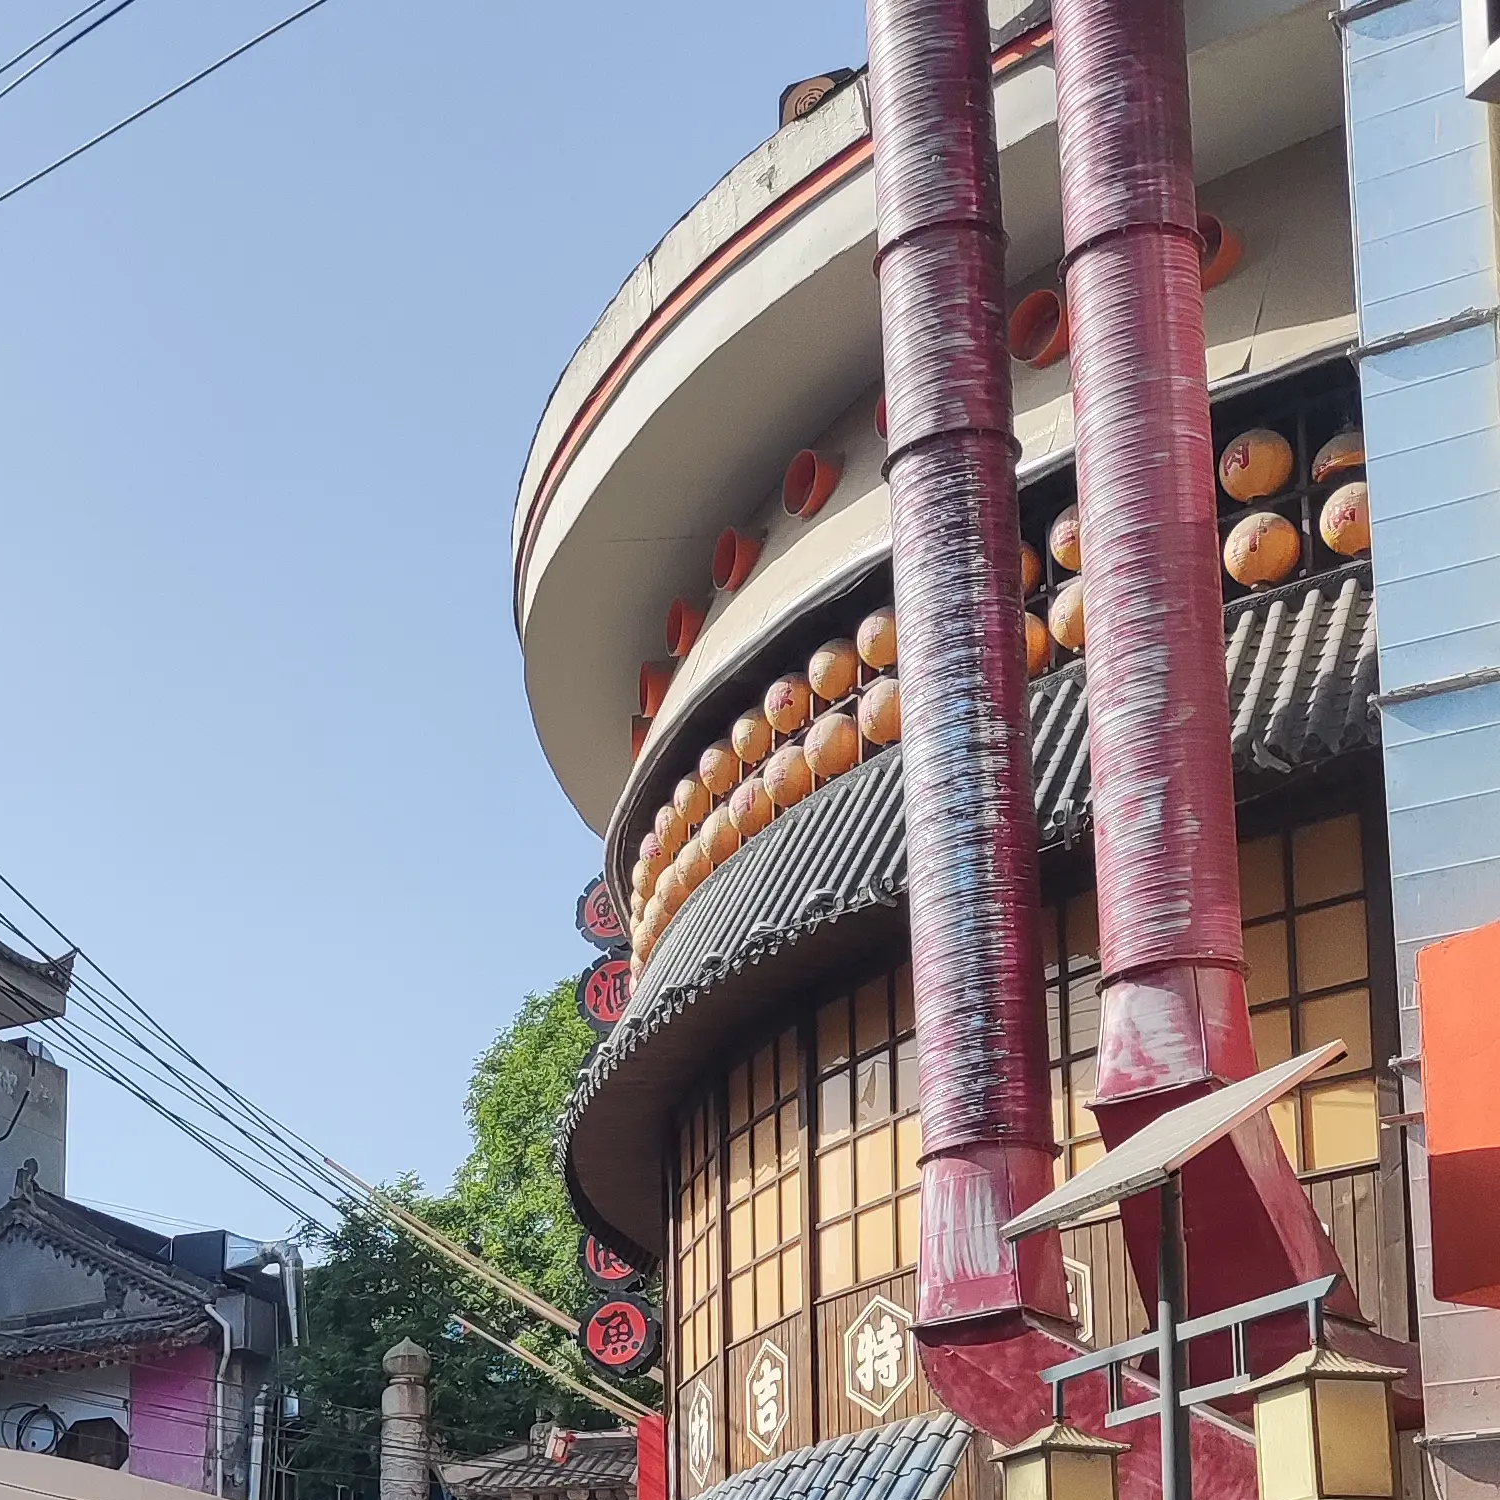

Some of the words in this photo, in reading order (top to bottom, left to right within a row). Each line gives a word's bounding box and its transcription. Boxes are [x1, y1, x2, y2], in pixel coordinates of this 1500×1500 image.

[595, 1310, 640, 1356] 魚
[856, 1314, 902, 1392] 特
[752, 1358, 783, 1433] 吉
